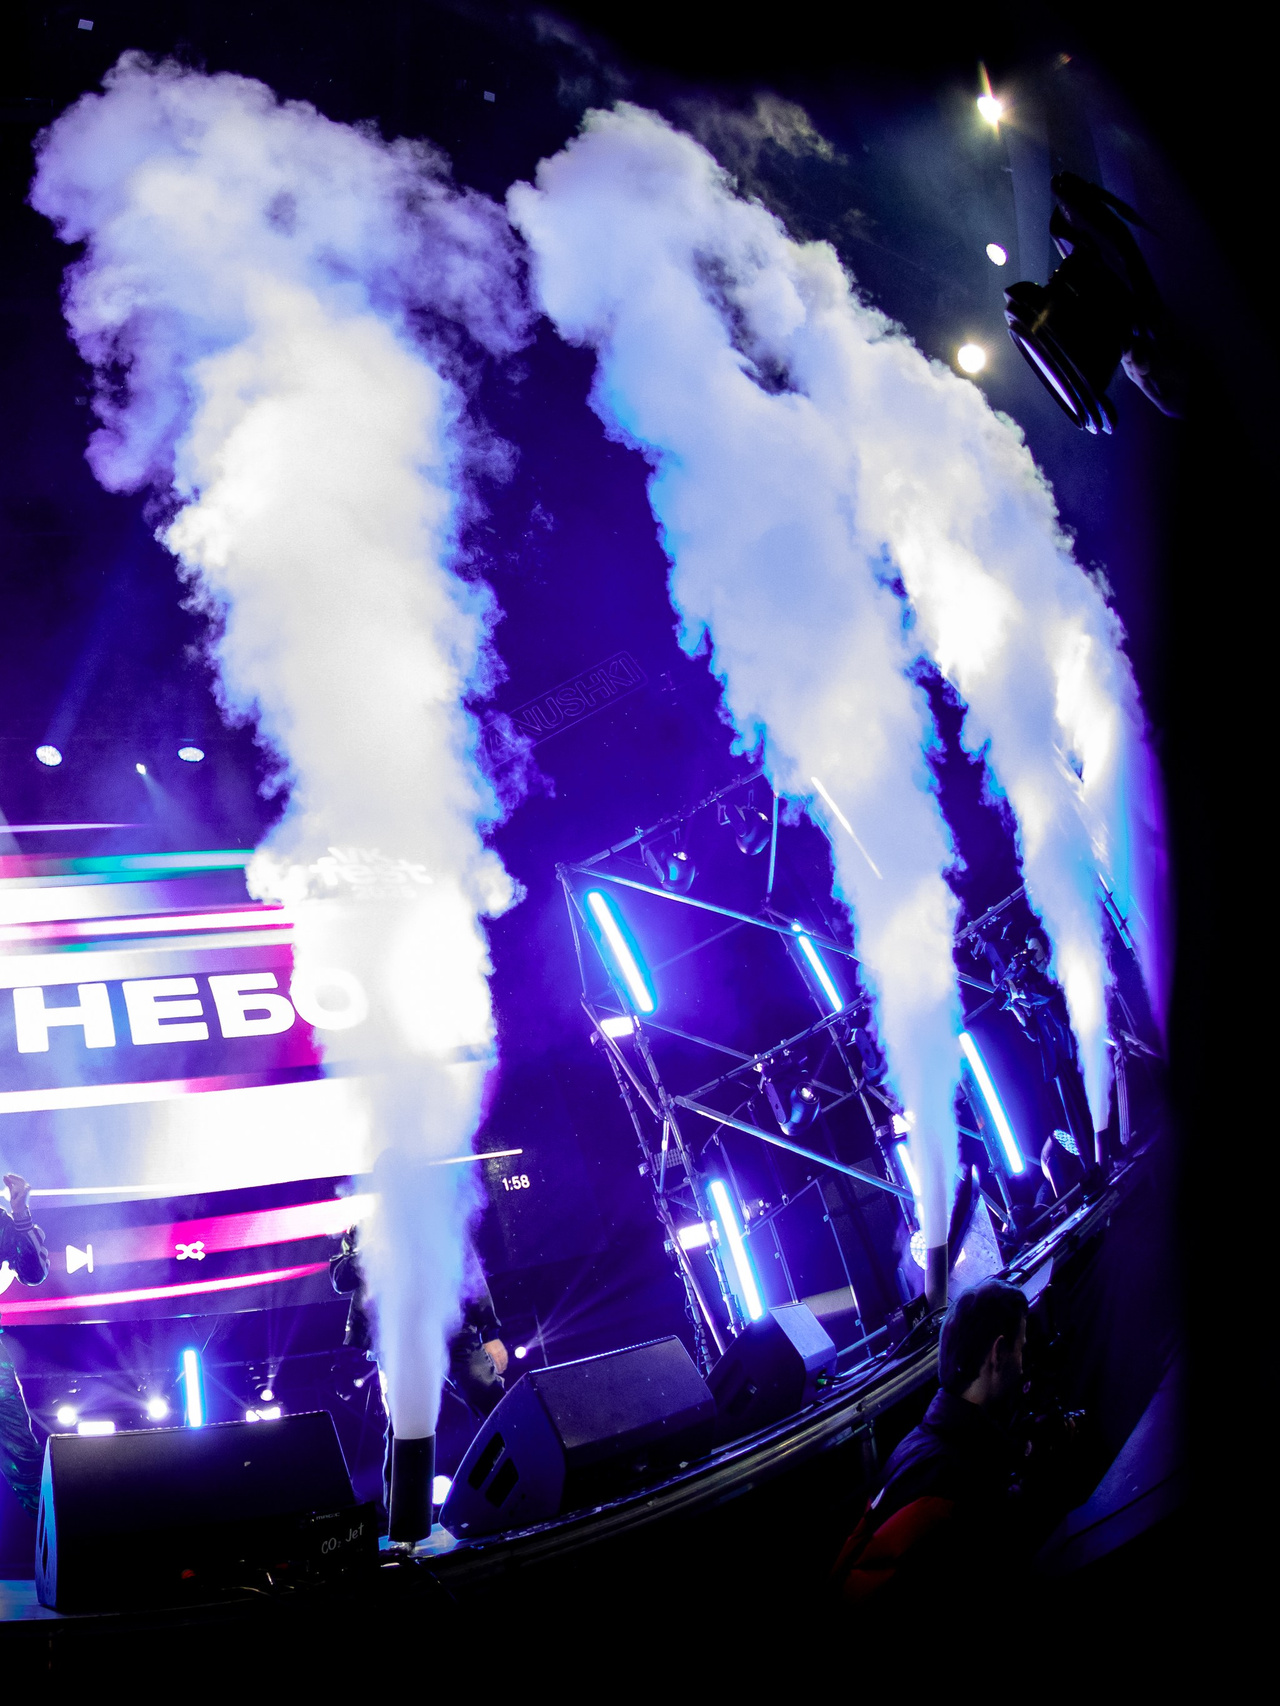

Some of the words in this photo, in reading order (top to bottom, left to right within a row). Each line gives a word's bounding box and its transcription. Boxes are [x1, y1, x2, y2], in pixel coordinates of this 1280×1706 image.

[12, 967, 369, 1055] НЕБО
[502, 1174, 531, 1192] 1:58
[345, 1521, 364, 1542] Jet
